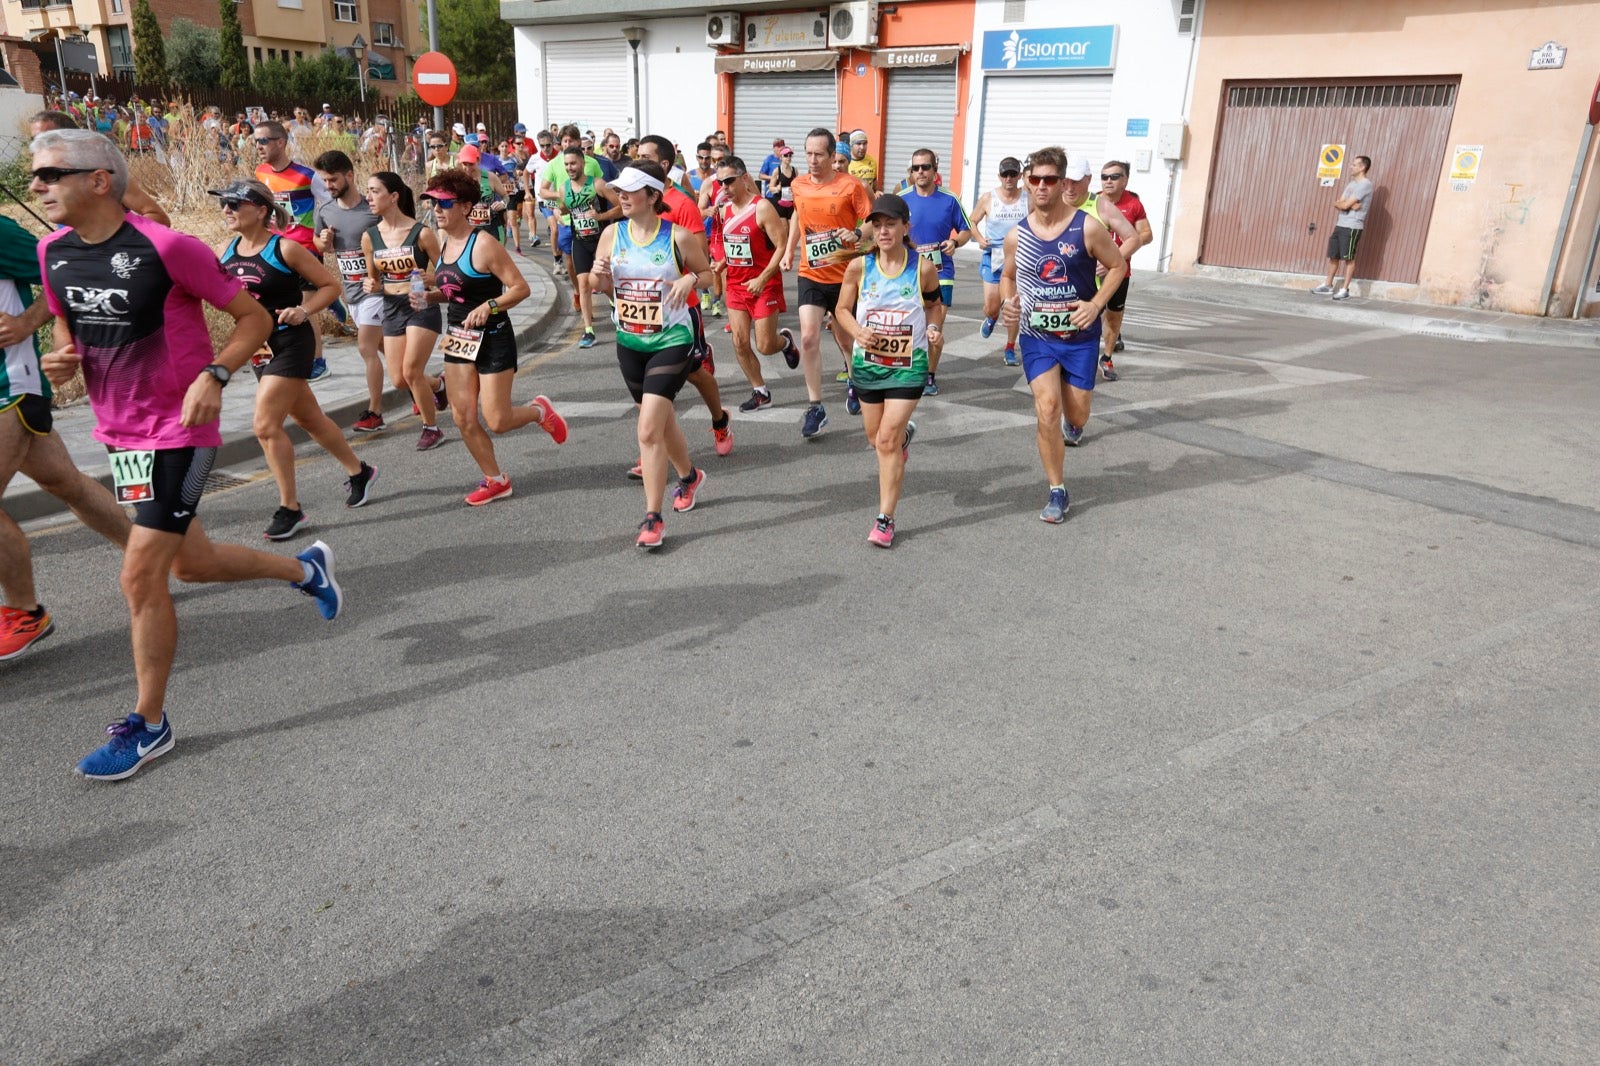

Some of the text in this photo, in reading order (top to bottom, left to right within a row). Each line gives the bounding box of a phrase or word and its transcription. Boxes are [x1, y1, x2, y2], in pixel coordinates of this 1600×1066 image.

[1017, 38, 1090, 62] fisiomar
[577, 219, 595, 228] 126
[730, 244, 743, 256] 72
[811, 242, 837, 257] 866
[341, 258, 367, 271] 3039
[381, 257, 413, 271] 2100
[621, 303, 660, 321] 2217
[1039, 313, 1071, 328] 394
[444, 338, 477, 355] 2249
[870, 338, 910, 353] 2297
